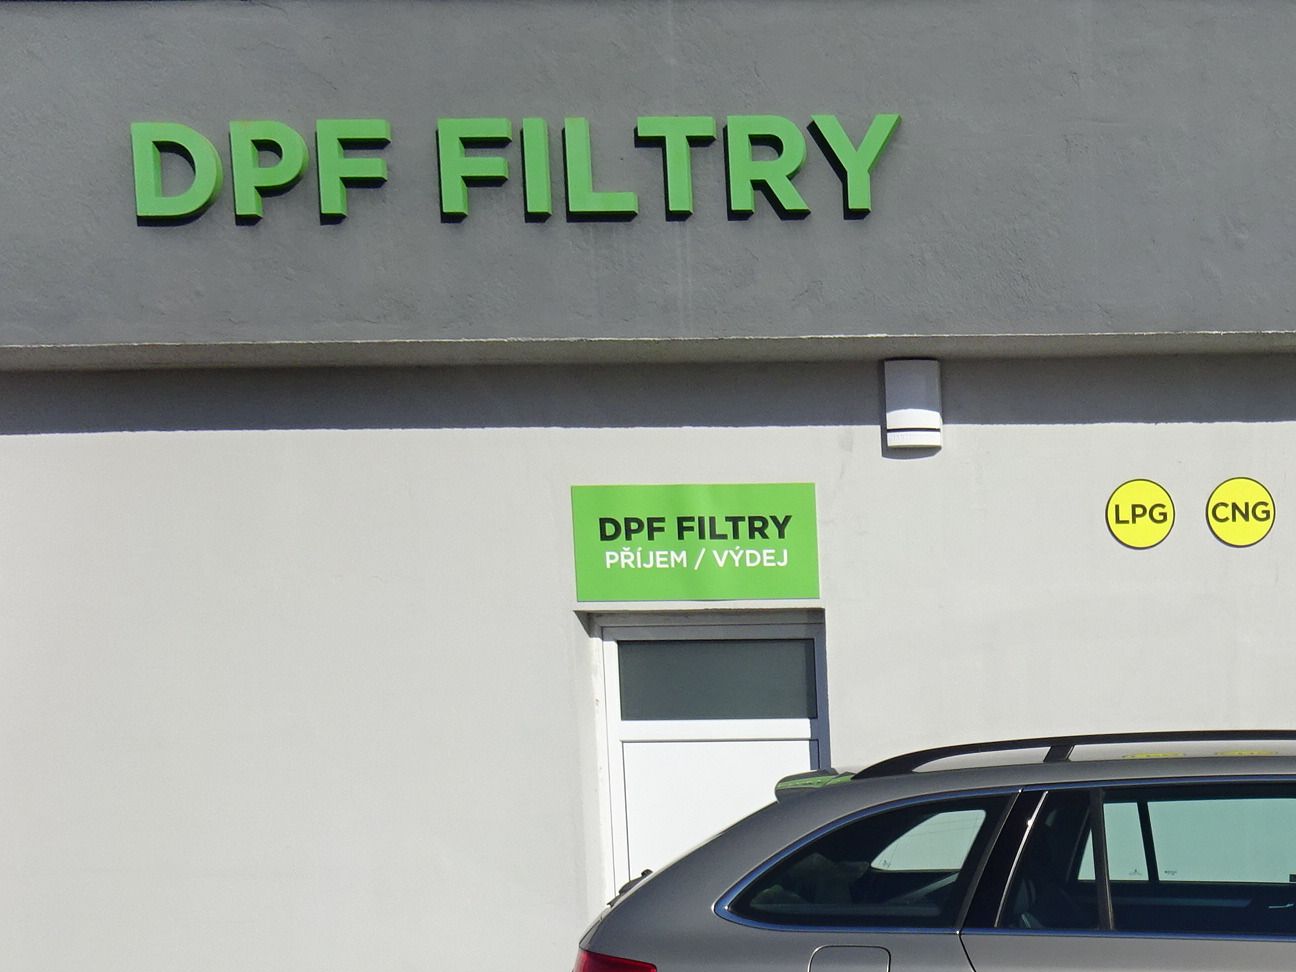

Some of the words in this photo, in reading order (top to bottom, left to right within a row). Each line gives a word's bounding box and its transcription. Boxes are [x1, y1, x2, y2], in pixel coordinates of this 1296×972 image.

[131, 117, 391, 221] DPF
[437, 114, 902, 220] FILTRY
[1114, 503, 1168, 525] LPG
[1211, 501, 1271, 523] CNG
[598, 516, 666, 541] DPF
[676, 515, 793, 541] FILTRY
[605, 547, 688, 569] PŘÍJEM
[694, 548, 706, 570] /
[712, 546, 789, 568] VÝDEJ
